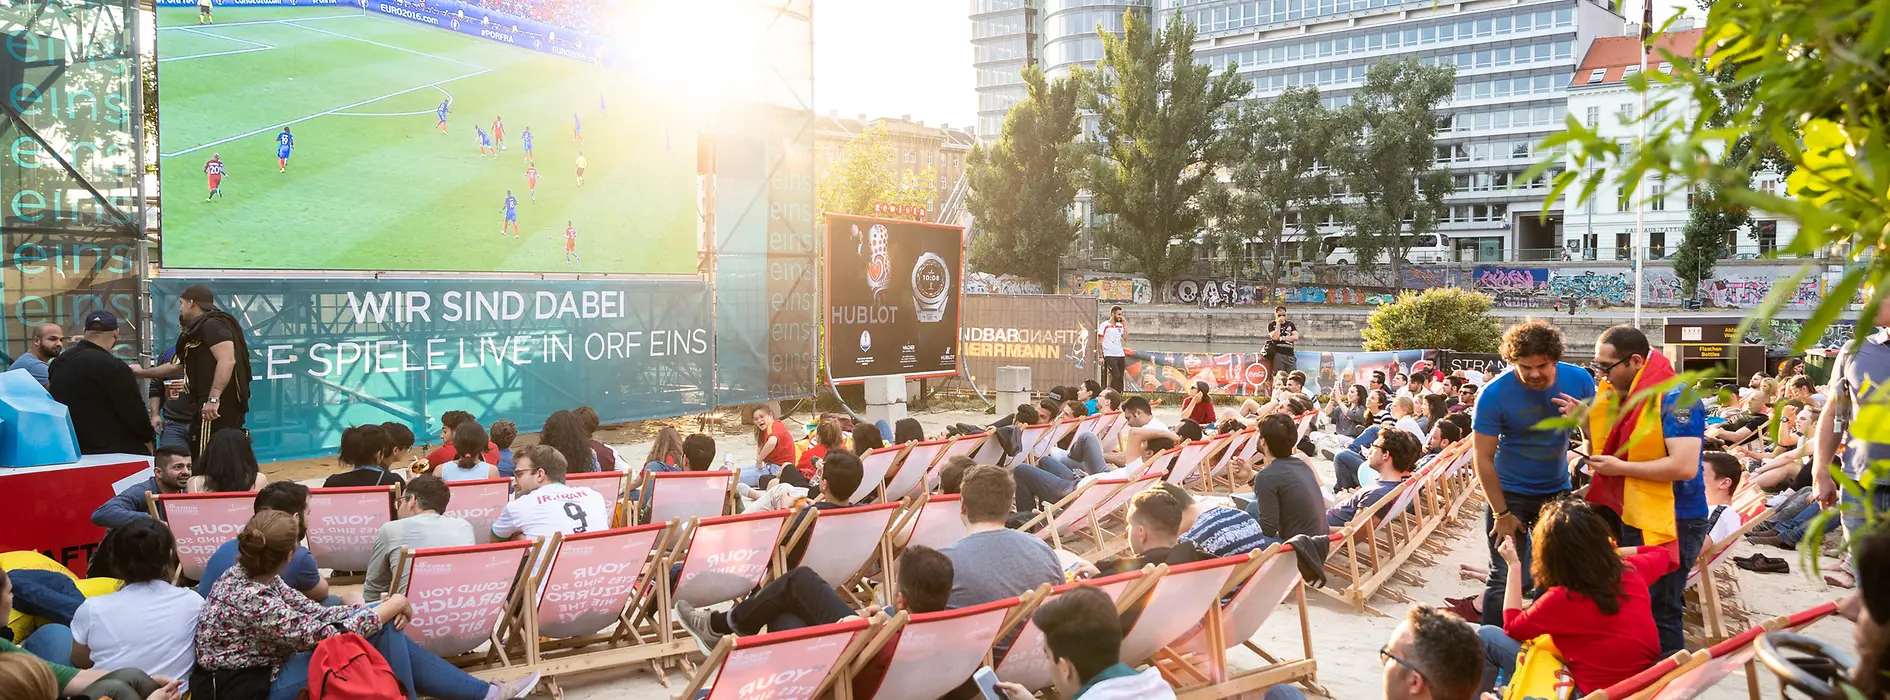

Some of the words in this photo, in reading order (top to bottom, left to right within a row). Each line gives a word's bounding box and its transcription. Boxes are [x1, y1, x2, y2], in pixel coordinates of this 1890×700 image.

[380, 3, 439, 25] EURO2016.com
[481, 29, 514, 43] #PORFRA
[9, 83, 128, 124] eins
[11, 136, 130, 174] ens
[770, 201, 812, 223] eins
[874, 202, 926, 216] gewista
[770, 231, 813, 252] eins
[13, 242, 133, 274] eins
[770, 261, 812, 281] eins
[15, 294, 133, 327] eins
[347, 291, 431, 324] WIR
[442, 290, 525, 322] SIND
[535, 290, 625, 320] DABEI
[771, 291, 811, 311] eins
[832, 305, 898, 324] HUBLOT
[771, 321, 811, 342] eins
[308, 338, 447, 377] SPIELE
[459, 335, 532, 368] LIVE
[543, 333, 573, 363] IN
[585, 331, 643, 361] ORF
[650, 328, 707, 357] EINS
[771, 352, 811, 372] eins
[563, 502, 588, 534] 9
